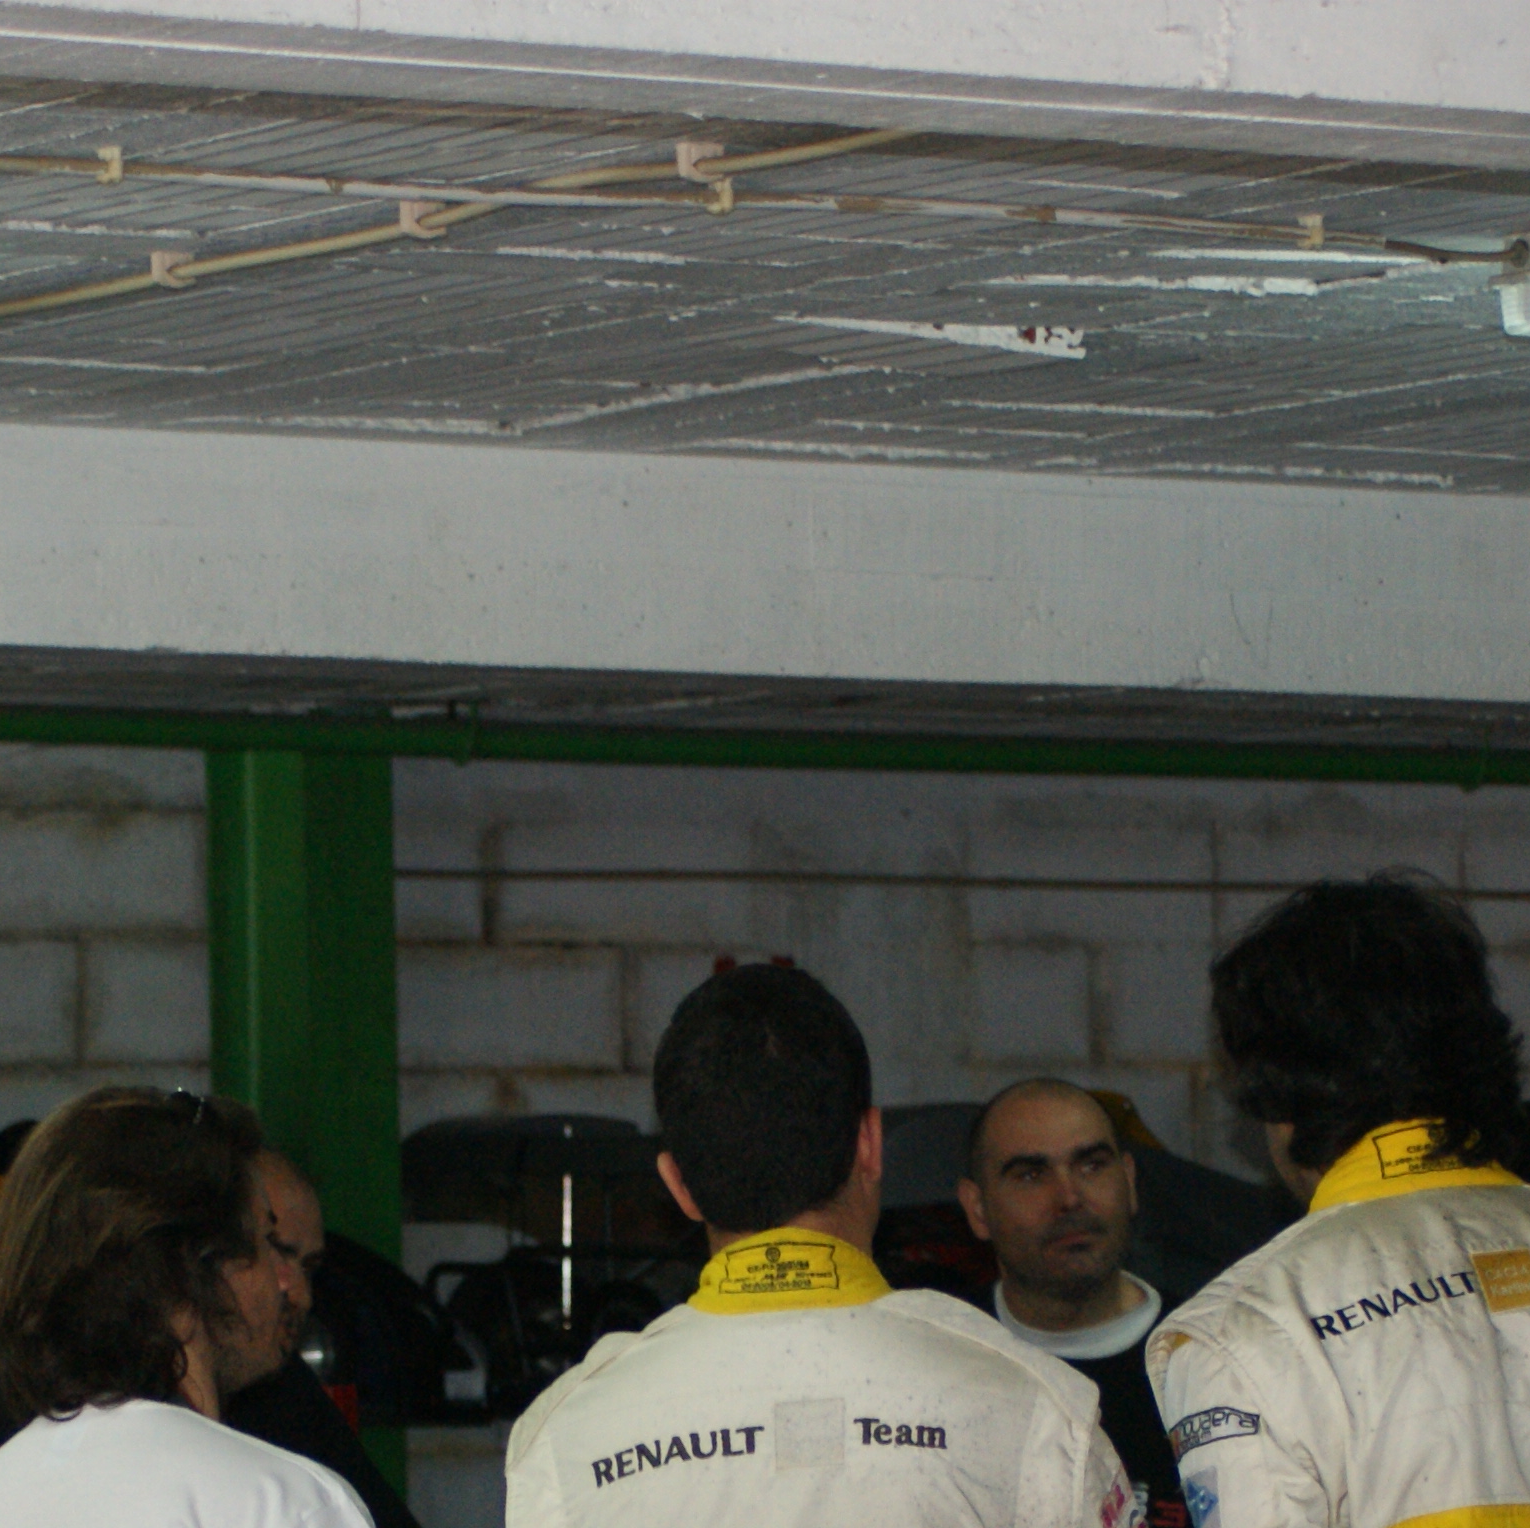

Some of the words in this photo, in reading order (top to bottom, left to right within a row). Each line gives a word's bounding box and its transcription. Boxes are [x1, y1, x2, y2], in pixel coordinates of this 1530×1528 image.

[1310, 1271, 1475, 1341] RENAULT
[591, 1426, 764, 1488] RENAULT
[853, 1417, 948, 1450] Team
